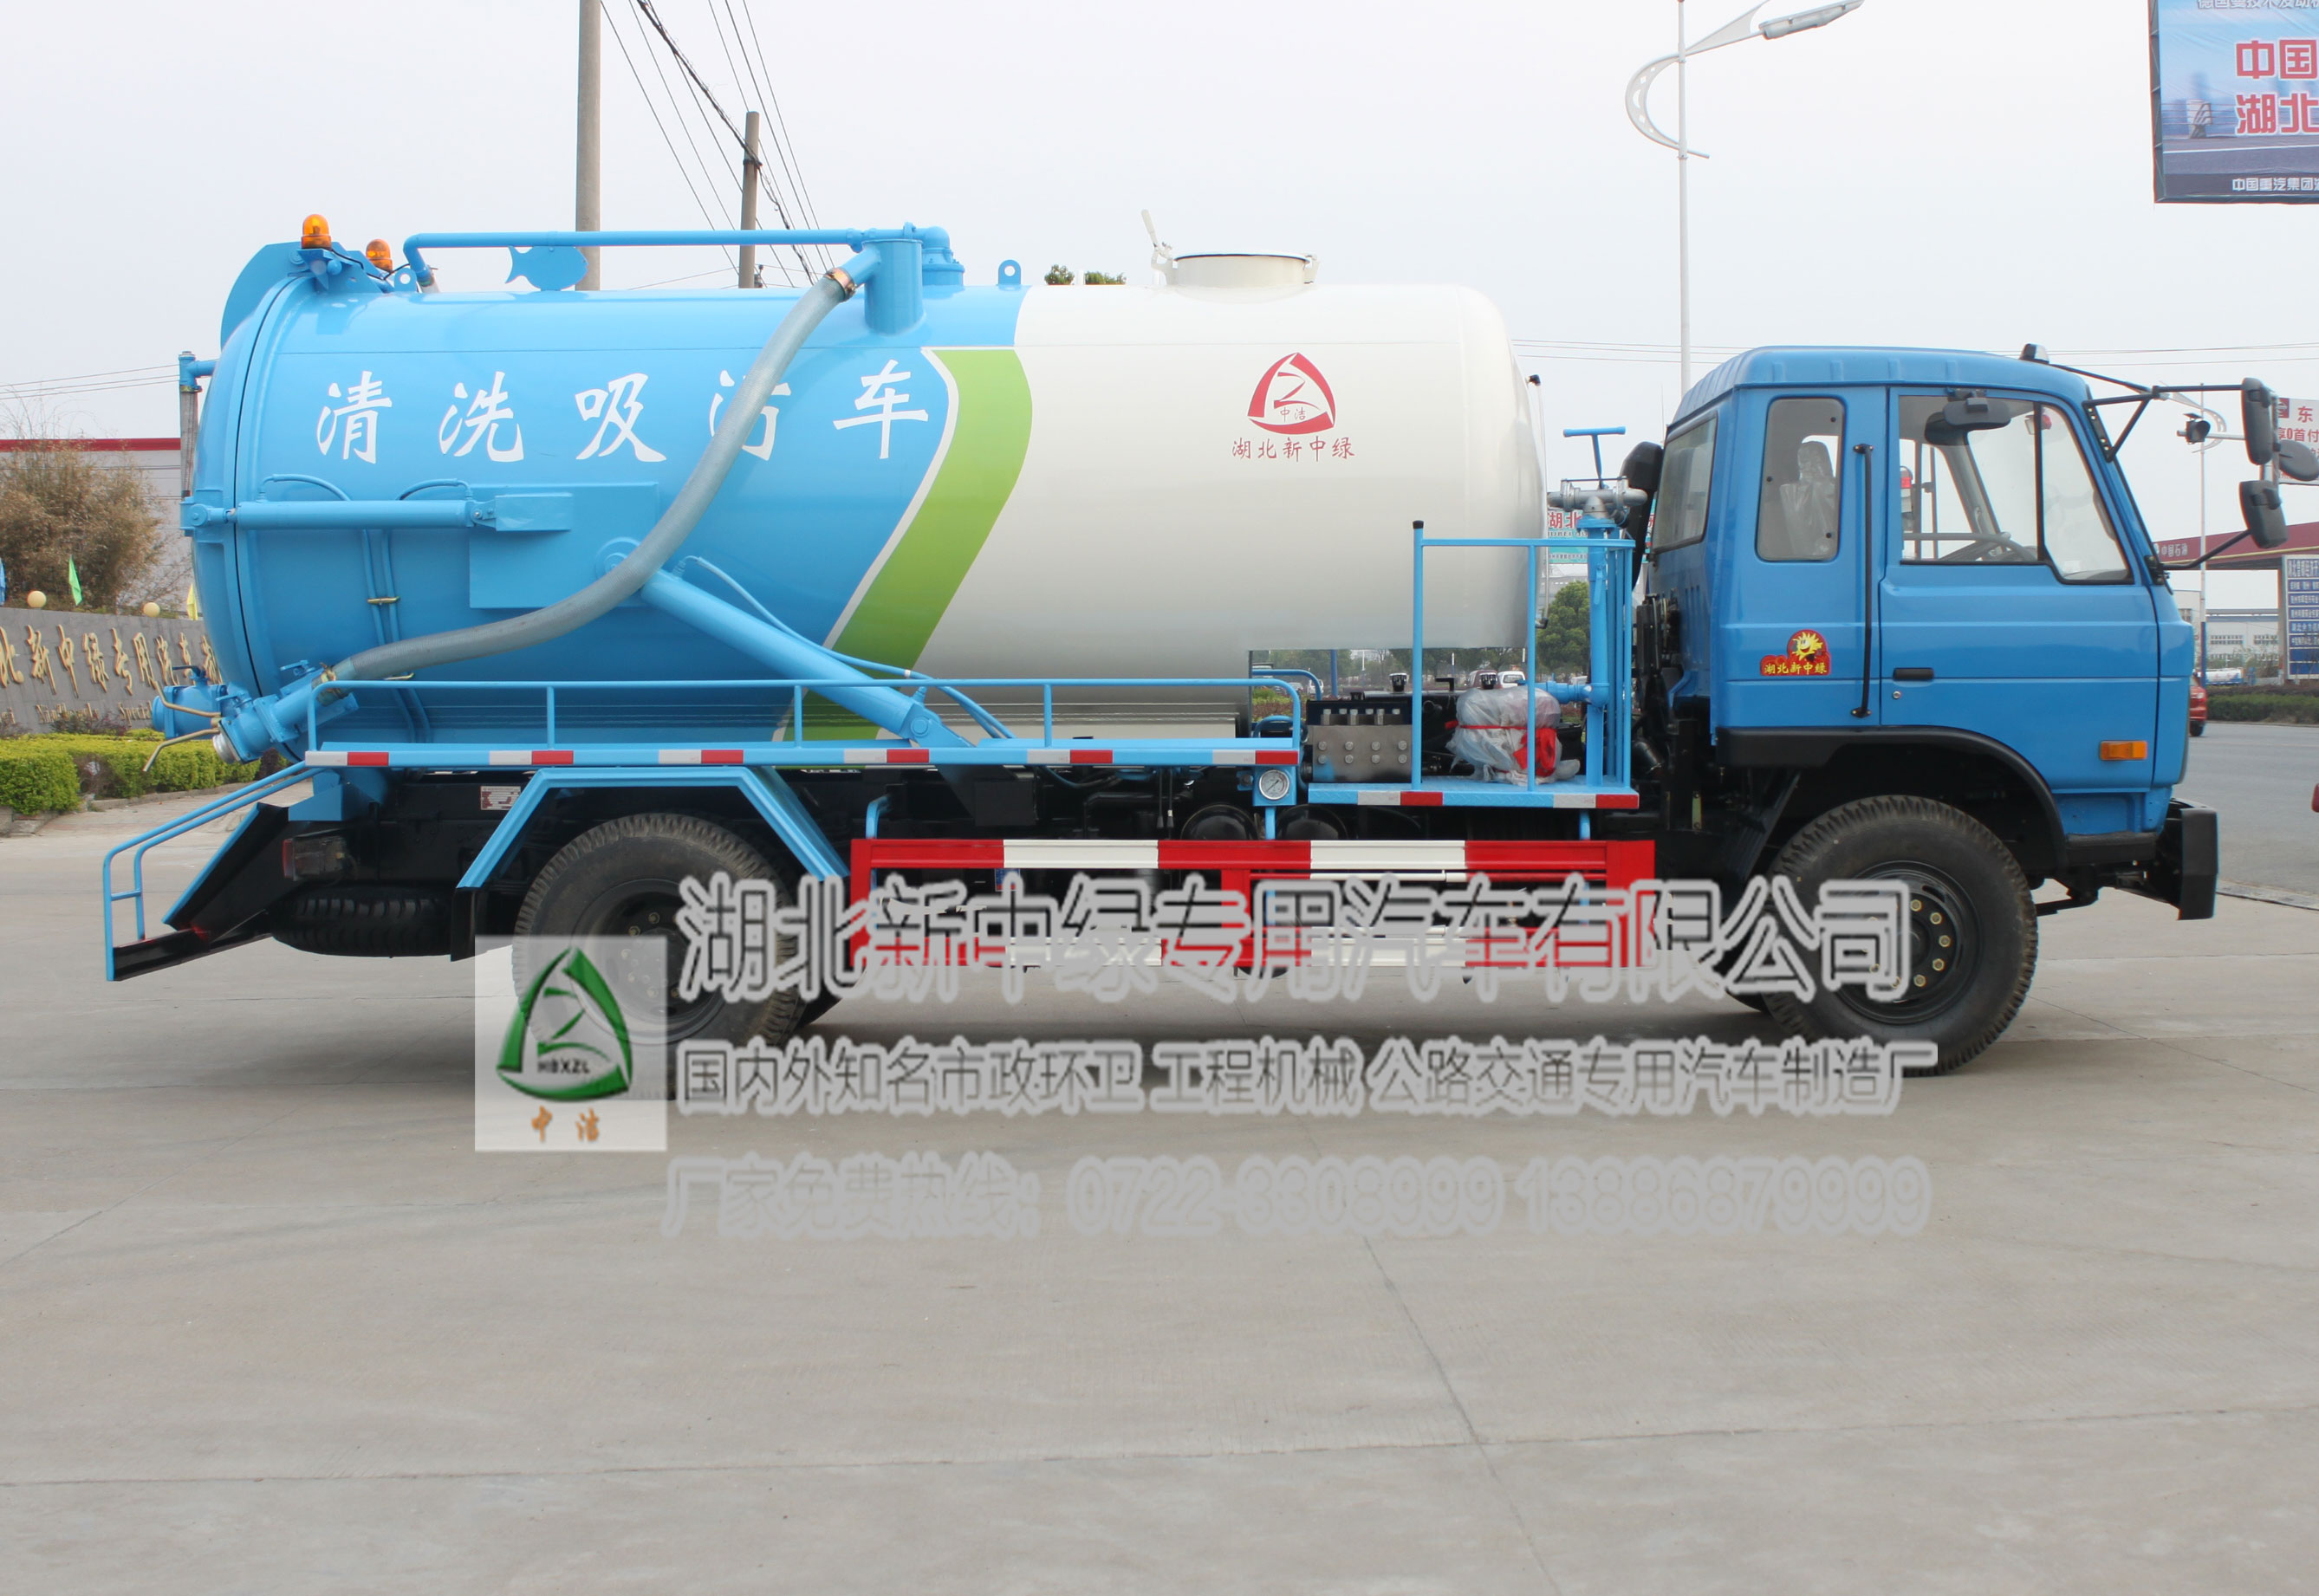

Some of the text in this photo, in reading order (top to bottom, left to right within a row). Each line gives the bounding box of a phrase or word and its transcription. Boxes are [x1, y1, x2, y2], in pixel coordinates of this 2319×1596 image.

[2235, 39, 2318, 80] 中国
[2235, 92, 2319, 134] 湖北
[1279, 406, 1306, 423] 中洁
[2297, 405, 2313, 423] 东
[1231, 435, 1355, 463] 湖北新中绿
